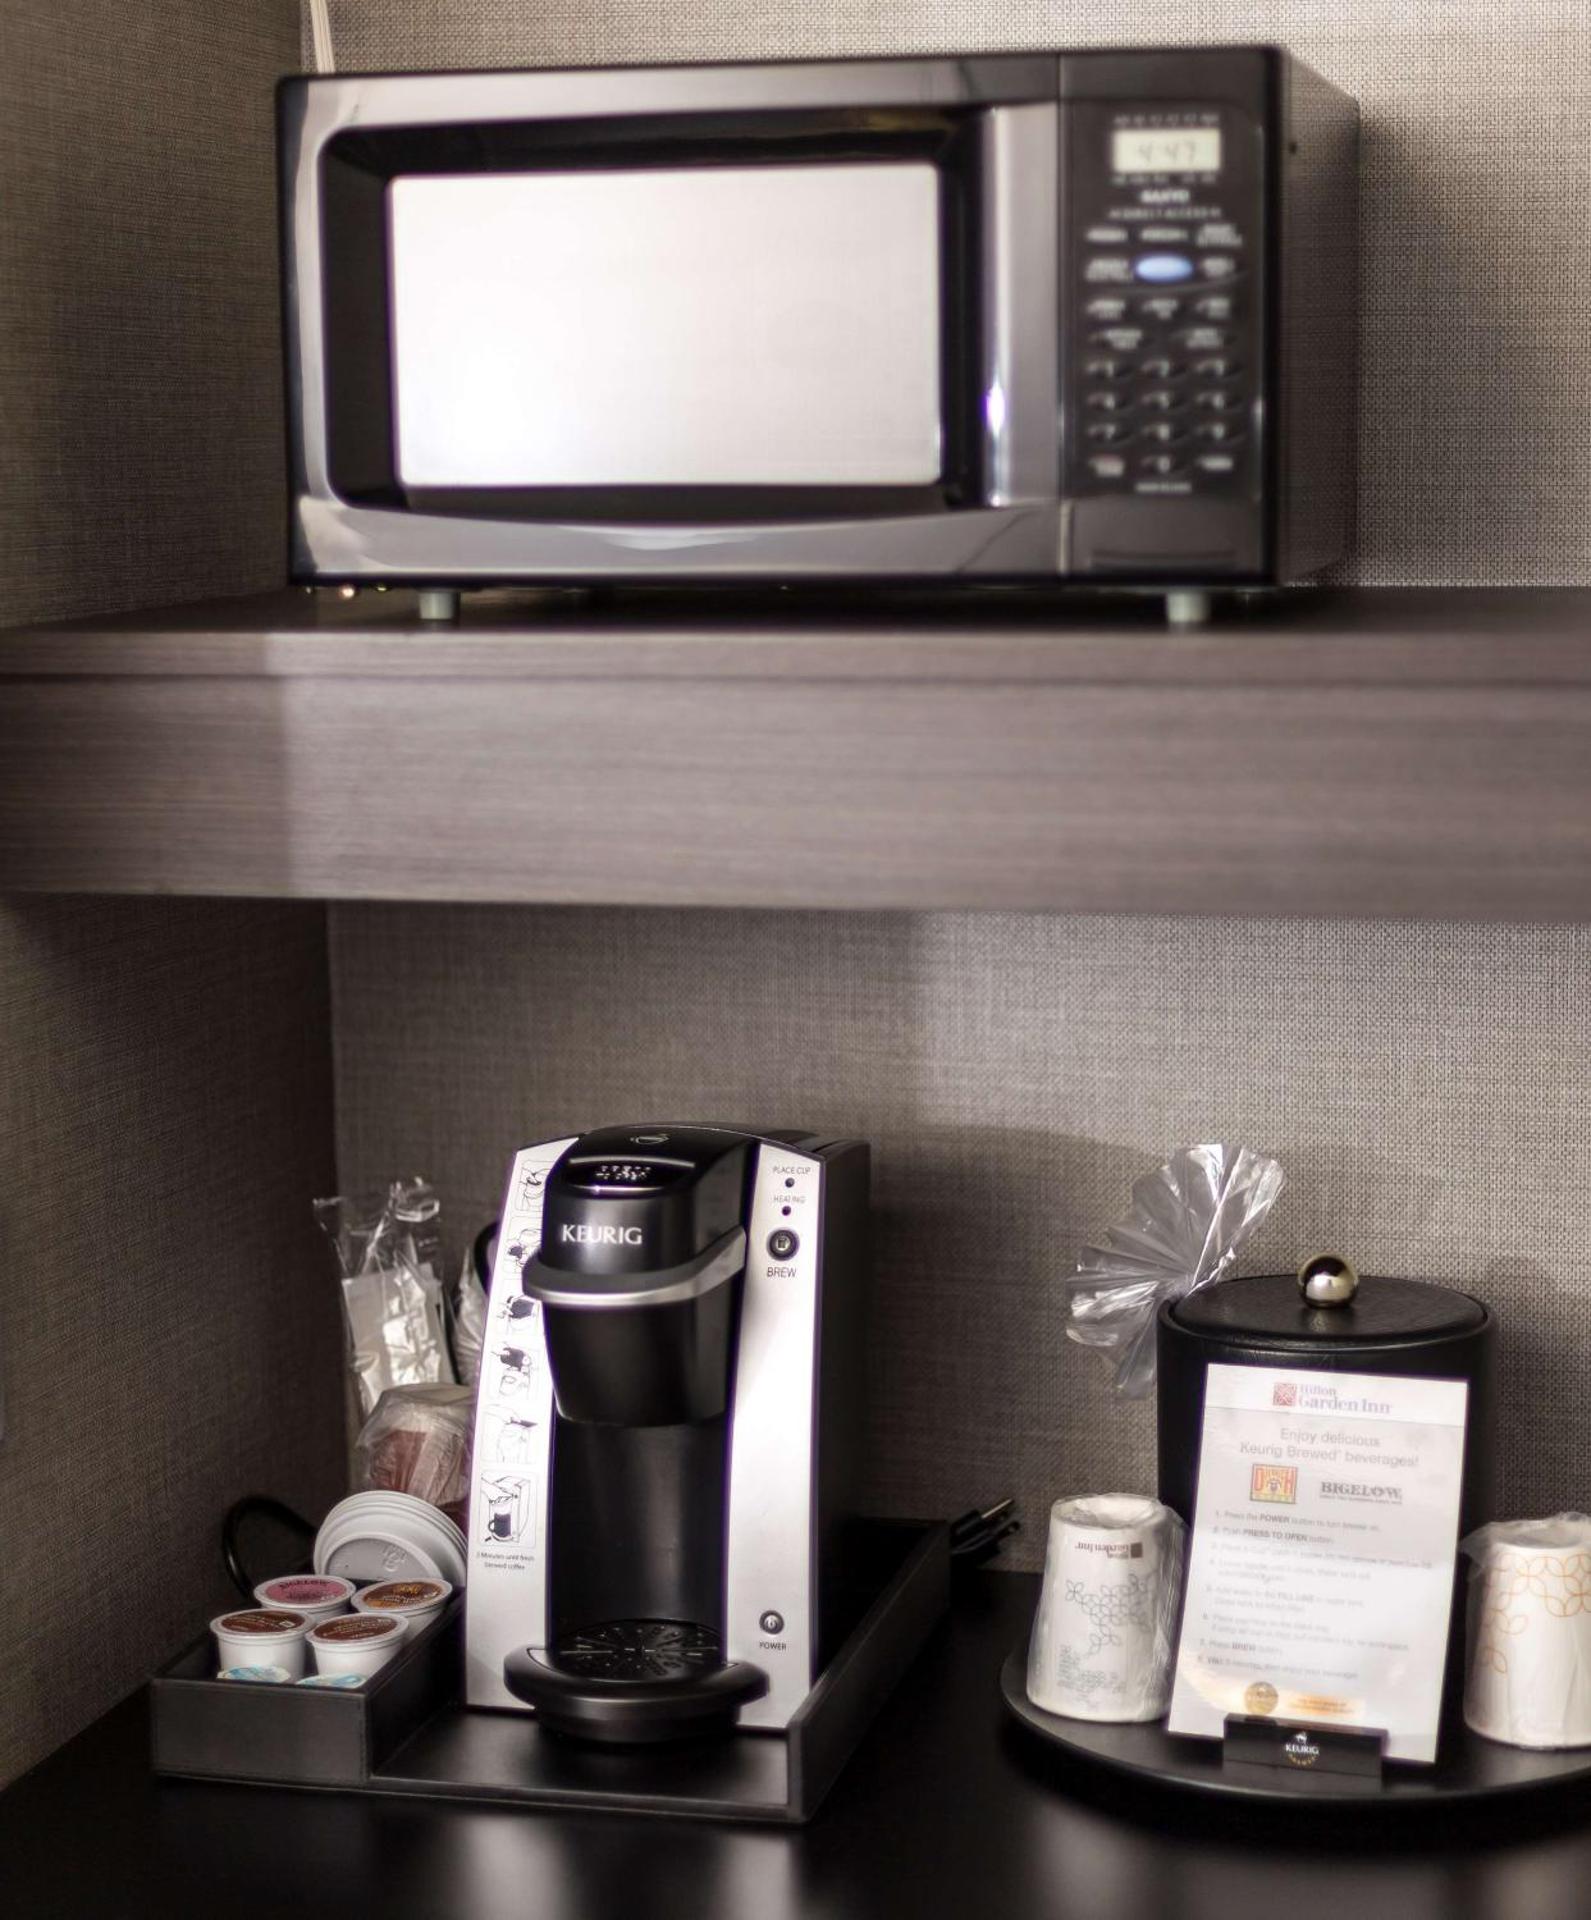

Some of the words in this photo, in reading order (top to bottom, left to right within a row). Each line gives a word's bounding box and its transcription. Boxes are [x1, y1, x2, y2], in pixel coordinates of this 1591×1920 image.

[772, 1166, 795, 1174] PLACE
[796, 1166, 811, 1175] CUP
[561, 1224, 643, 1245] KEURIG
[766, 1266, 797, 1278] BREW
[1299, 1395, 1359, 1411] Garden
[1362, 1398, 1391, 1414] Inn
[1280, 1427, 1318, 1444] Enjoy
[1321, 1431, 1382, 1448] delicious
[1239, 1442, 1282, 1458] Keurig
[1321, 1481, 1402, 1499] BIGELOW
[1259, 1513, 1290, 1524] POWER
[759, 1641, 787, 1651] POWER
[1285, 1743, 1320, 1755] KEURIG
